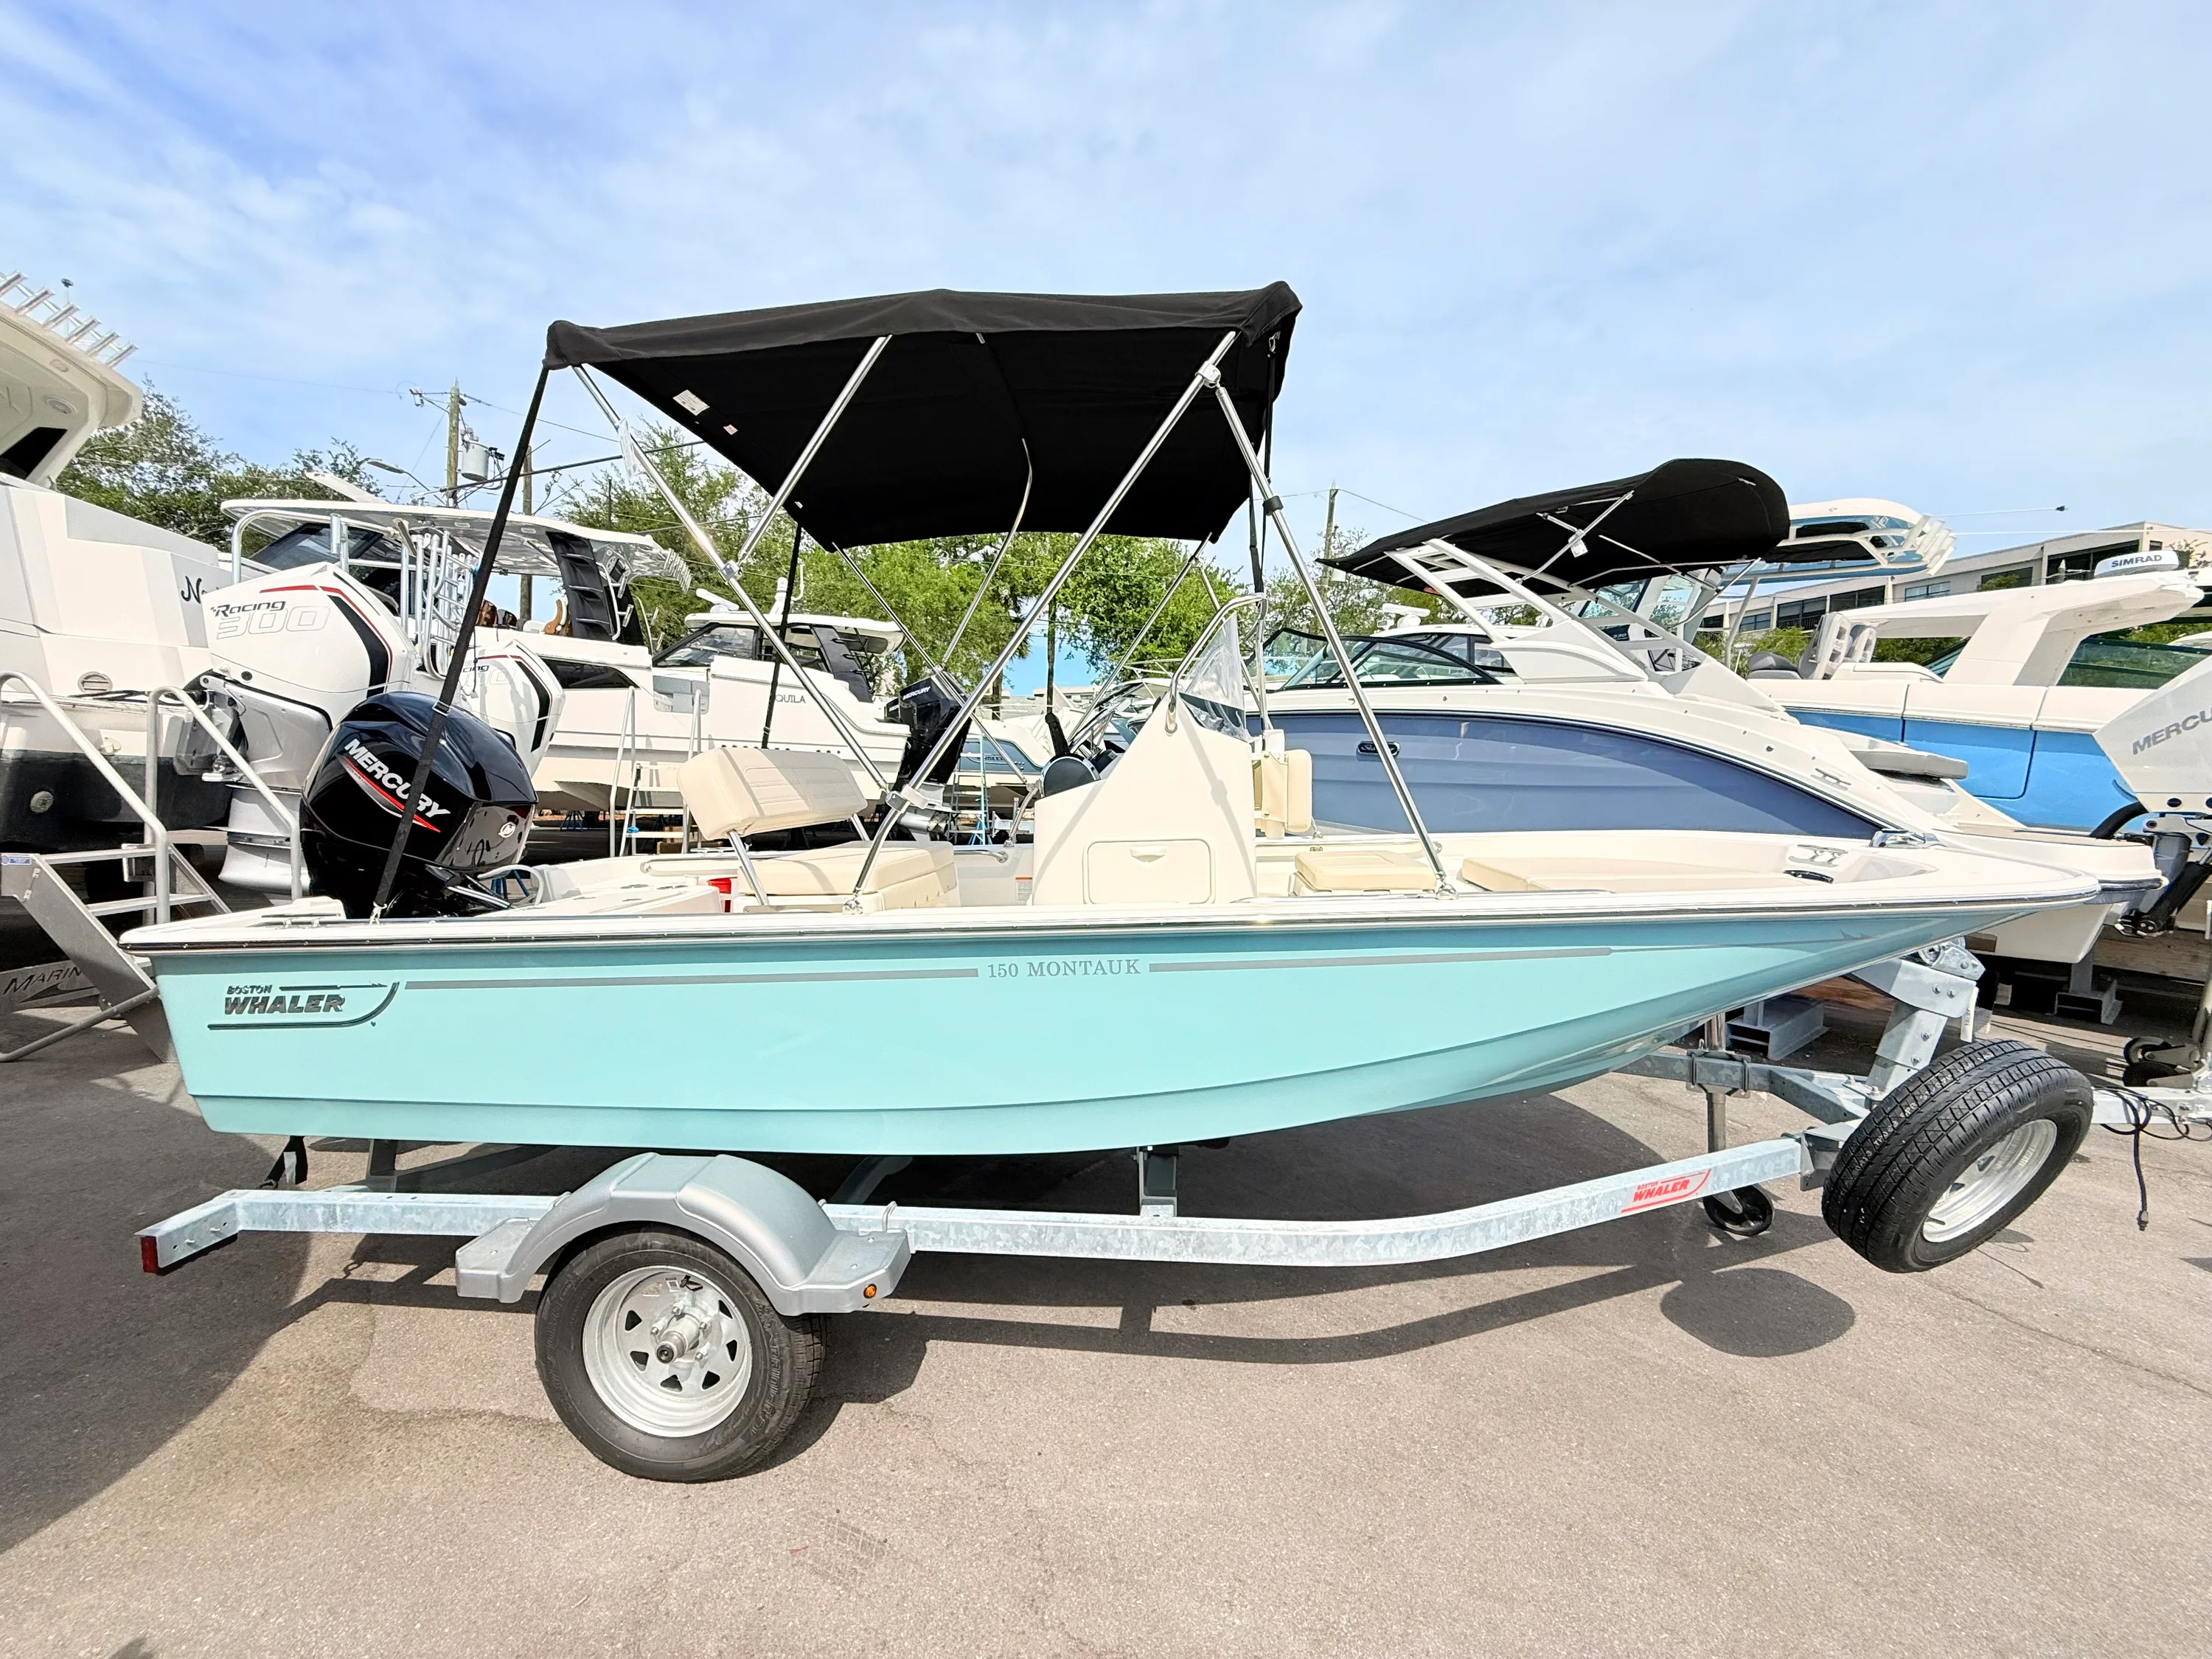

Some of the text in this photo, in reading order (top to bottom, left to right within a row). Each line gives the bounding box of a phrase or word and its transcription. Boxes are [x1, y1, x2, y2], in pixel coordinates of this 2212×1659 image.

[2111, 554, 2163, 568] SIMRAD
[212, 601, 287, 617] Racing
[216, 605, 330, 640] 300
[775, 694, 806, 703] QUILA
[902, 686, 931, 701] MERCURY
[2132, 706, 2212, 755] MERCU
[987, 959, 1141, 978] 150 MONTAUK
[3, 967, 82, 995] MARIN
[226, 984, 273, 995] BOSTON
[224, 995, 346, 1015] WHALER
[1633, 1180, 1690, 1203] WHALER
[1637, 1181, 1659, 1190] BOSTON
